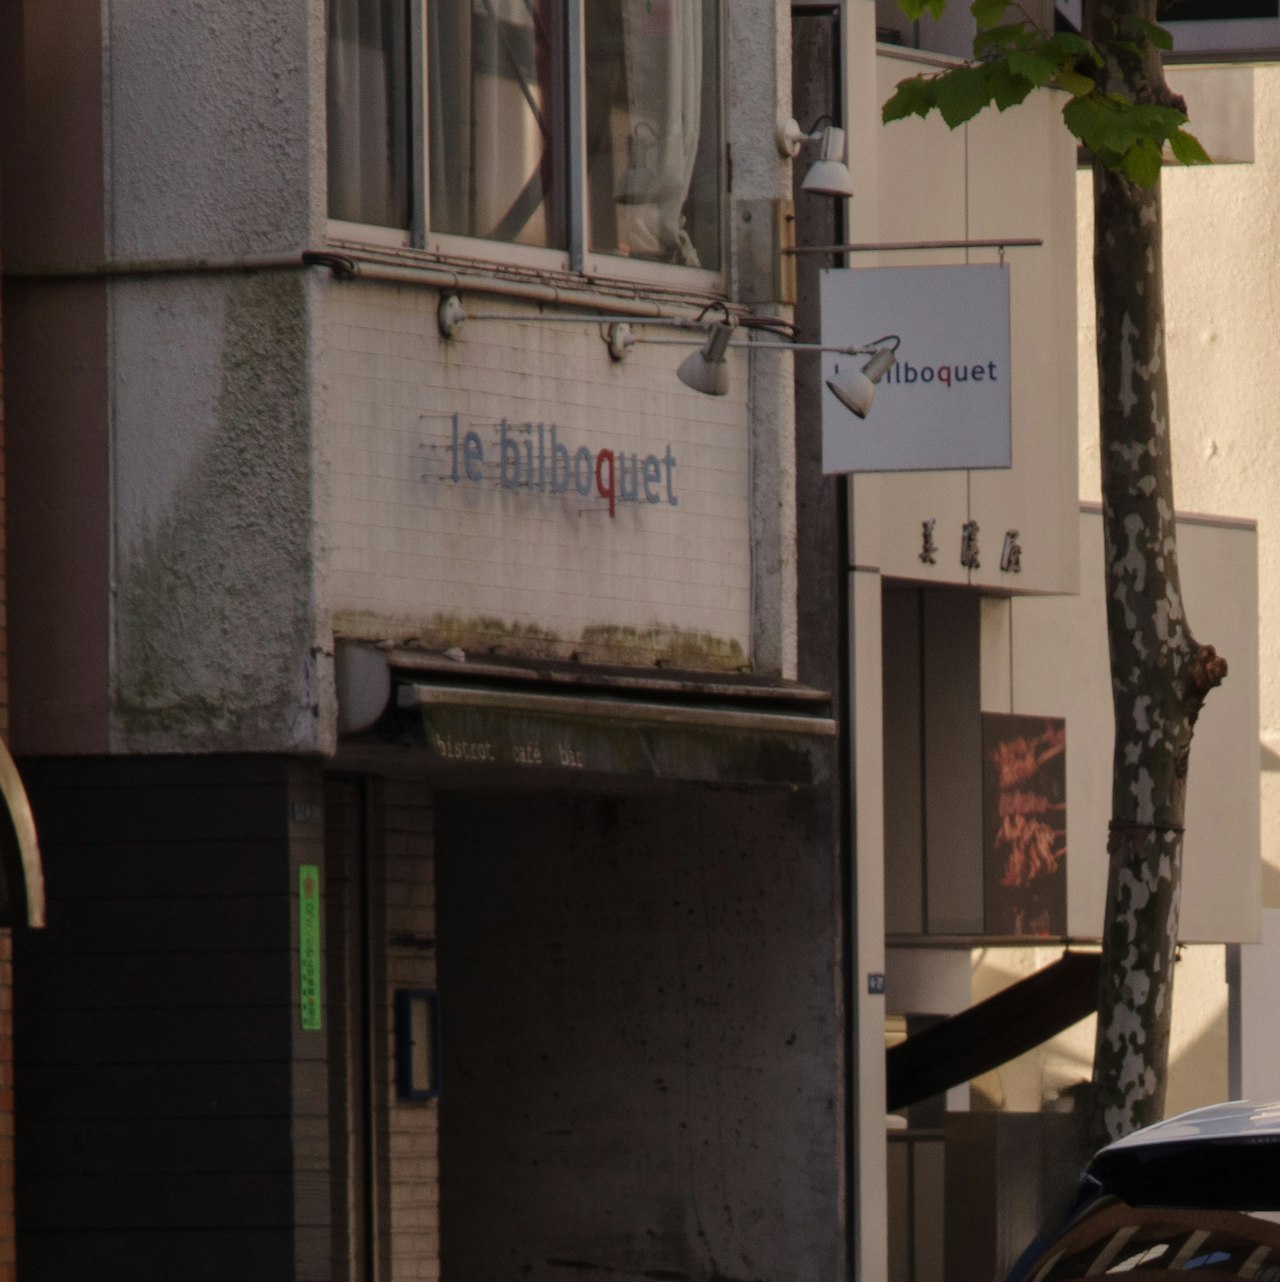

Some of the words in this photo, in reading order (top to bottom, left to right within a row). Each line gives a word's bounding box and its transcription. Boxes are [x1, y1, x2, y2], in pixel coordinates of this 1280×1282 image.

[880, 361, 998, 387] ilboquet
[451, 411, 484, 483] le
[501, 418, 678, 519] bilboquet
